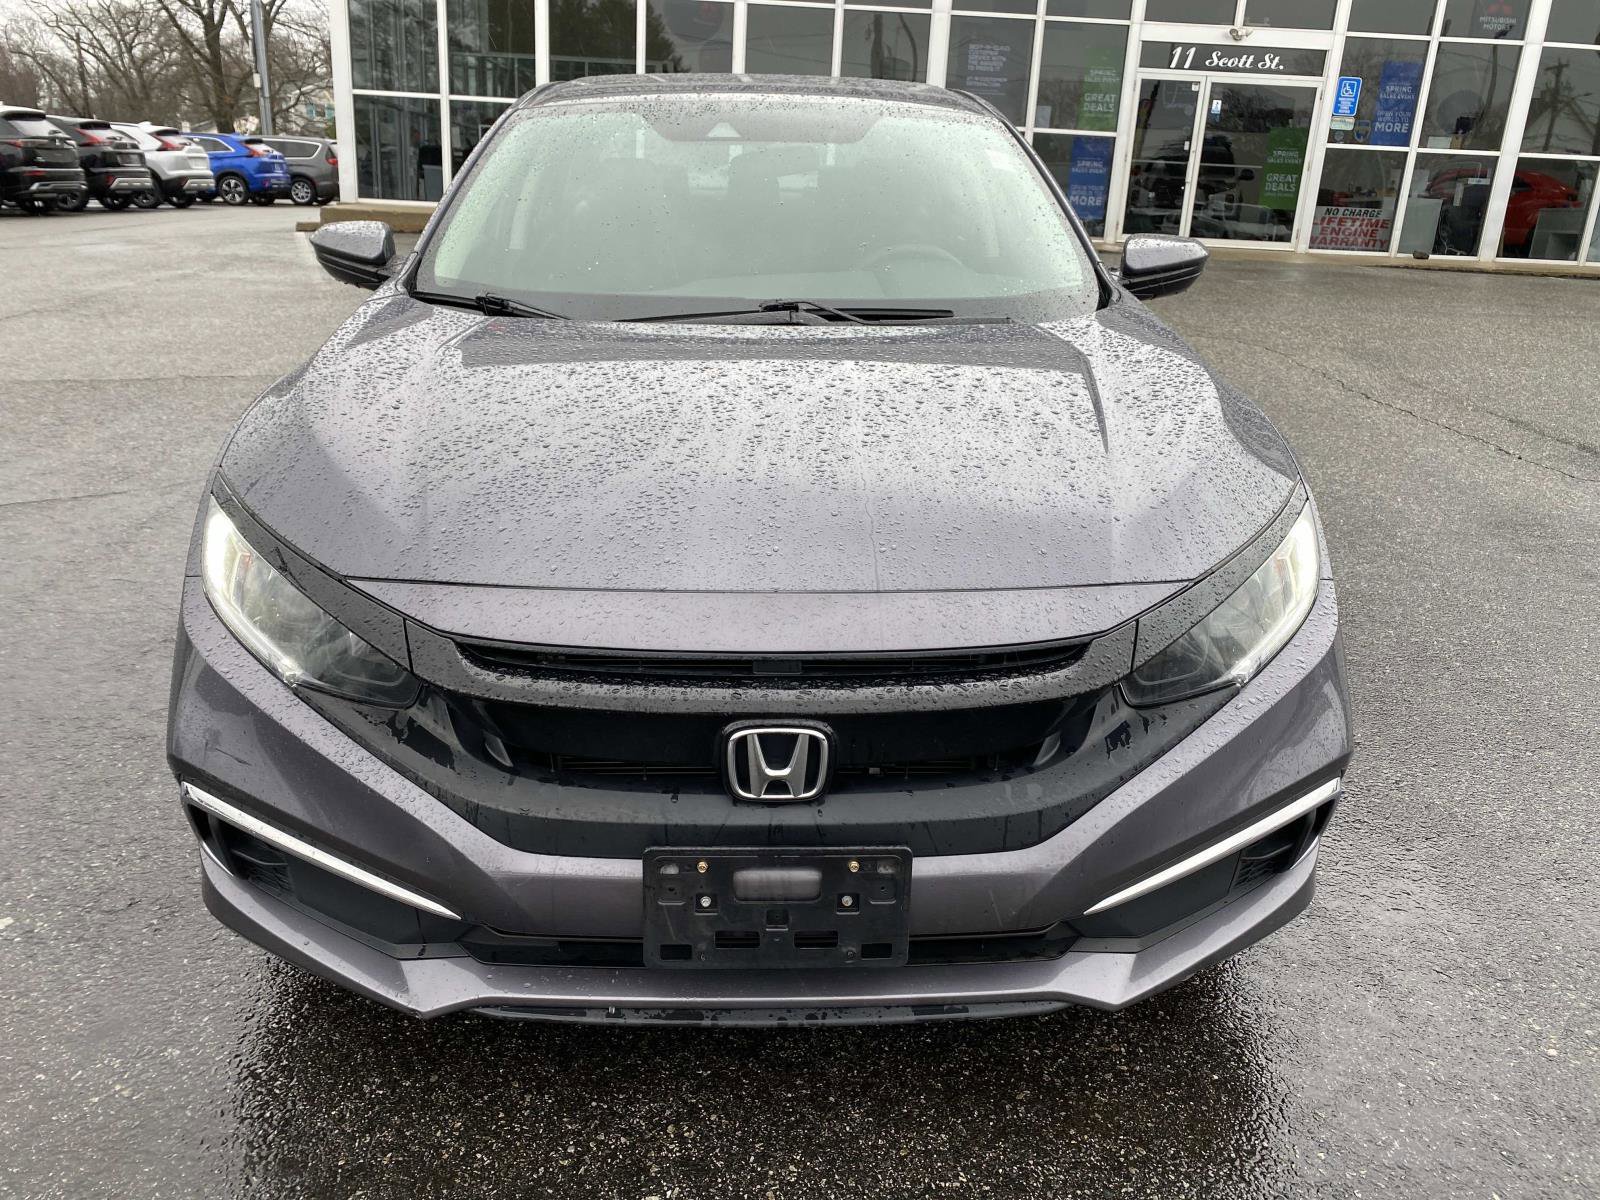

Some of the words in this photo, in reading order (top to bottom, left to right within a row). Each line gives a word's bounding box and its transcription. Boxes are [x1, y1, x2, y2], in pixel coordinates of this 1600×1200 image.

[1169, 46, 1197, 69] 11
[1205, 50, 1254, 69] Scott
[1258, 52, 1284, 70] St.
[1386, 85, 1412, 93] SPRING
[1084, 93, 1116, 103] GREAT
[1083, 102, 1115, 112] DEALS
[1374, 122, 1409, 133] MORE
[1266, 173, 1298, 183] GREAT
[1265, 183, 1296, 192] DEALS
[1070, 195, 1103, 206] MORE
[1325, 208, 1340, 216] NO
[1342, 208, 1382, 217] CHARGE
[1312, 216, 1391, 229] LIFETIME
[1319, 226, 1379, 238] ENGINE
